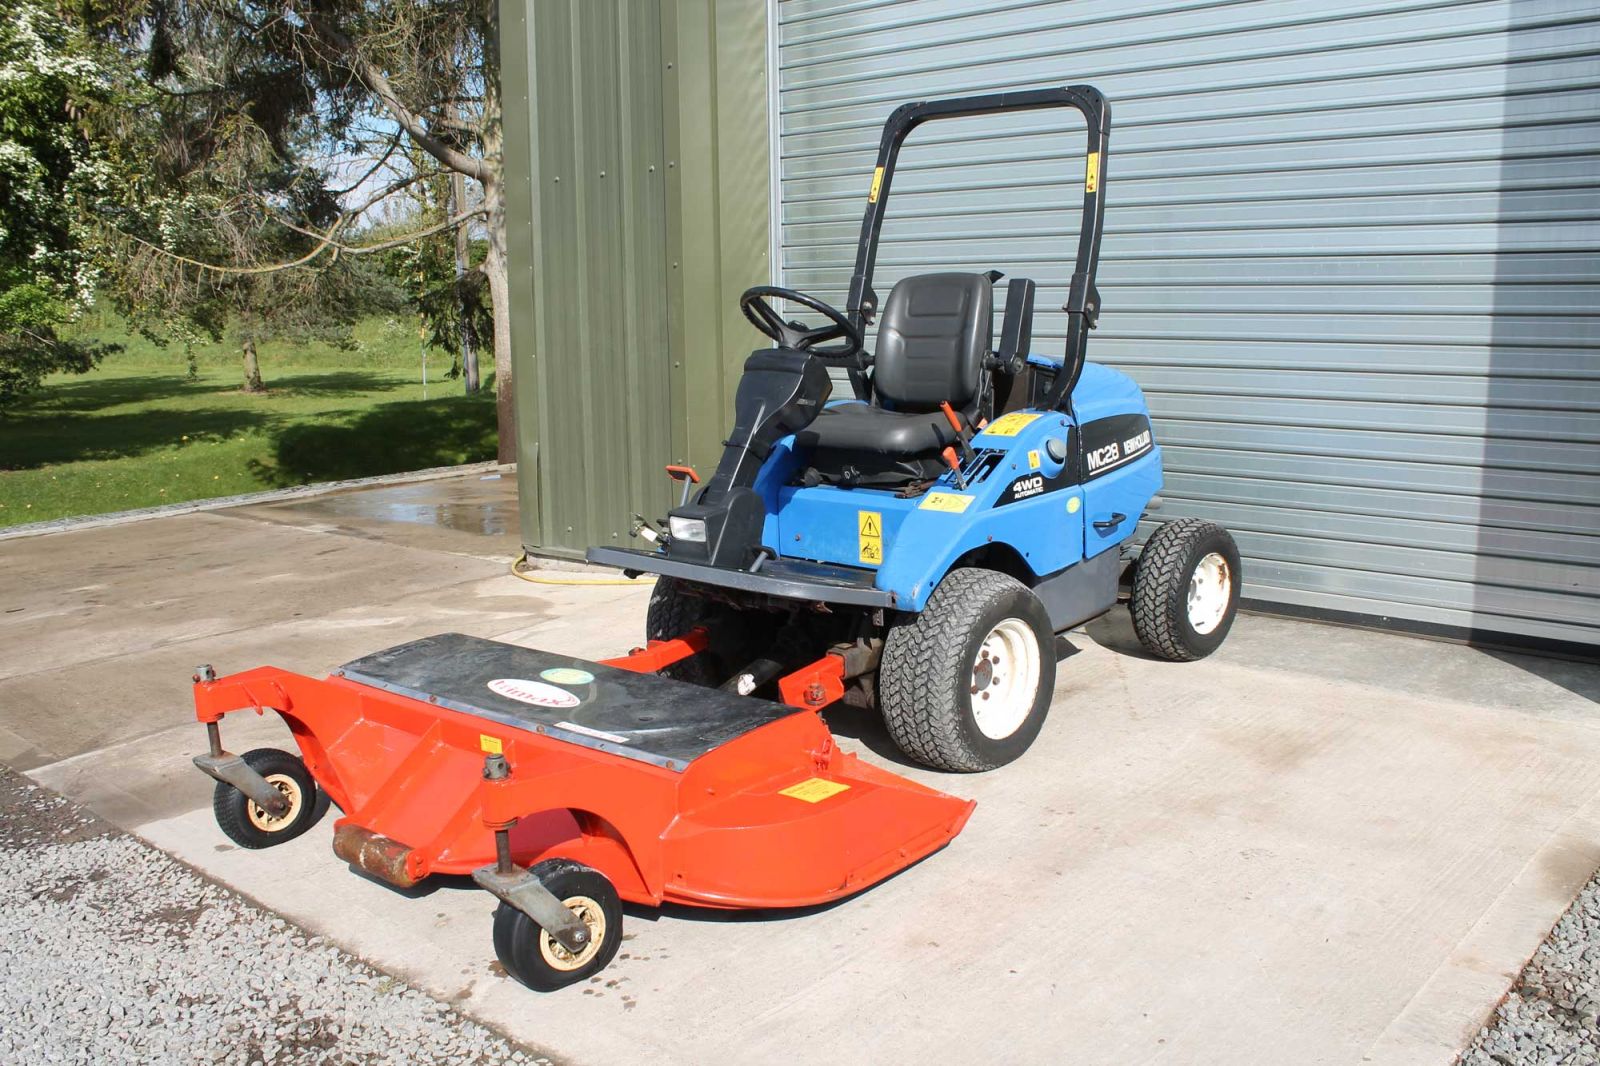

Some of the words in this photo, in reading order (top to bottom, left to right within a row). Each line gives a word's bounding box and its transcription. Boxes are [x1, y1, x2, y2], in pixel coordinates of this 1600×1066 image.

[1086, 442, 1120, 471] MC28
[1013, 476, 1043, 492] 4WD
[1014, 487, 1044, 499] AUTOMATIC
